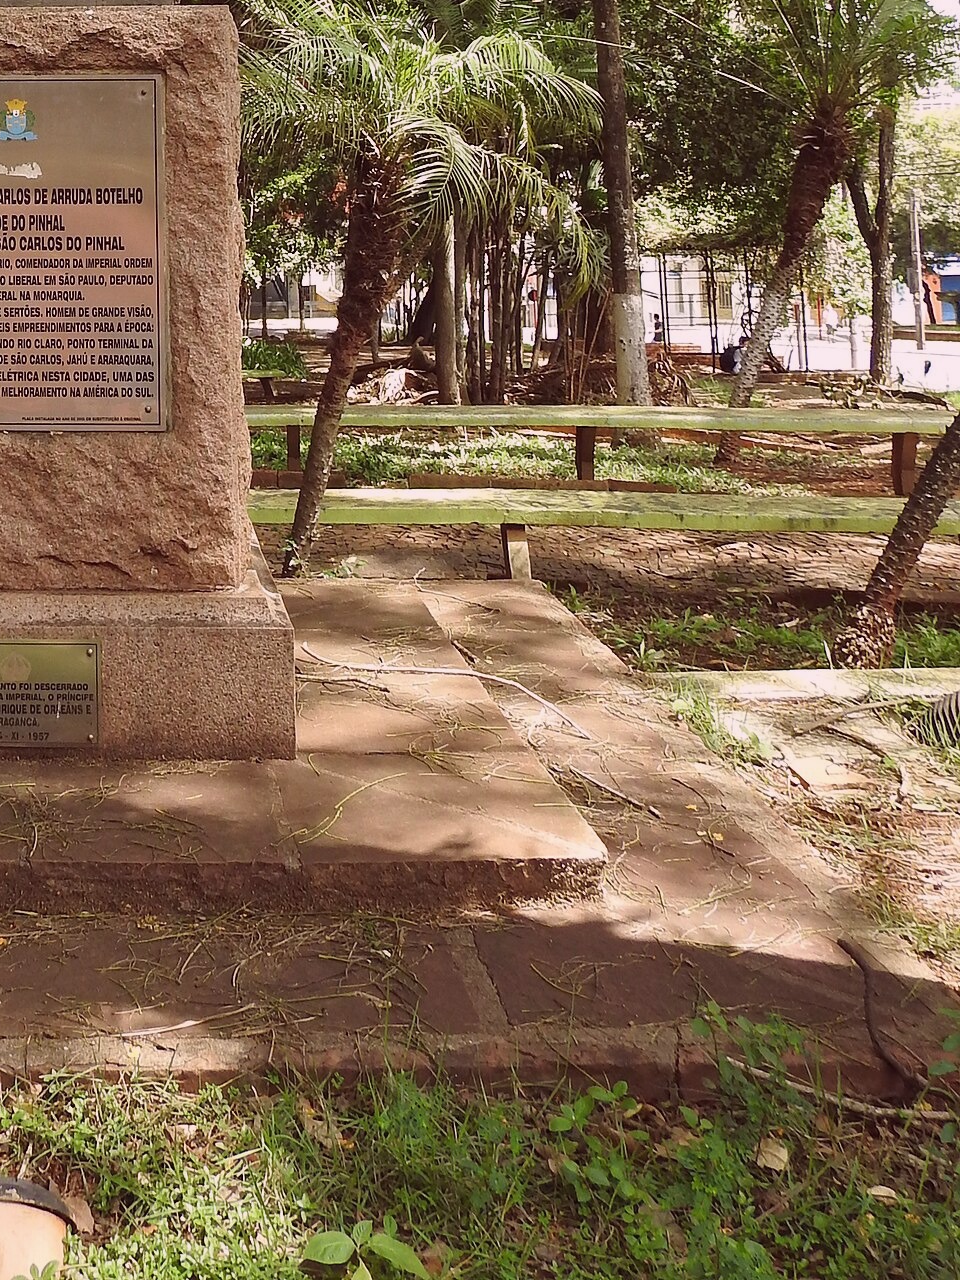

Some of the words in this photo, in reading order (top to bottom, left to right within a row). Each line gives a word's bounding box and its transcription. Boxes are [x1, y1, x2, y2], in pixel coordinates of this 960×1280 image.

[34, 188, 47, 204] DE
[51, 188, 92, 204] ARRUDA
[96, 188, 143, 204] BOTELHO
[12, 215, 25, 231] DO
[29, 215, 65, 231] PINHAL
[20, 236, 62, 251] CARLOS
[66, 236, 82, 251] DO
[86, 236, 124, 251] PINHAL
[16, 258, 70, 268] COMENDADOR
[72, 258, 83, 268] DA
[86, 258, 121, 268] IMPERIAL
[124, 258, 152, 268] ORDEM
[9, 275, 41, 285] LIBERAL
[44, 275, 56, 285] EM
[59, 273, 75, 285] SÃO
[78, 275, 107, 287] PAULO,
[110, 275, 153, 285] DEPUTADO
[20, 291, 30, 301] NA
[34, 291, 85, 302] MONARQUIA.
[46, 307, 76, 317] HOMEM
[79, 307, 89, 317] DE
[92, 307, 125, 317] GRANDE
[128, 304, 154, 318] VISÃO,
[13, 322, 91, 332] EMPREENDIMENTOS
[94, 322, 114, 332] PARA
[117, 322, 122, 332] A
[125, 320, 154, 332] ÉPOCA:
[18, 339, 32, 348] RIO
[34, 339, 64, 350] CLARO,
[68, 339, 95, 348] PONTO
[98, 339, 139, 348] TERMINAL
[142, 339, 153, 348] DA
[11, 352, 27, 364] SÃO
[30, 354, 64, 366] CARLOS,
[67, 352, 88, 364] JAHÚ
[90, 354, 95, 364] E
[98, 354, 154, 366] ARARAQUARA,
[42, 371, 70, 381] NESTA
[74, 372, 109, 383] CIDADE,
[112, 371, 132, 381] UMA
[136, 371, 154, 381] DAS
[2, 387, 67, 397] MELHORAMENTO
[70, 387, 80, 397] NA
[83, 385, 118, 397] AMÉRICA
[121, 387, 132, 397] DO
[135, 387, 154, 397] SUL.
[57, 692, 93, 701] PRÍNCIPE
[30, 704, 41, 714] DE
[86, 704, 91, 714] E
[11, 732, 18, 740] XI
[28, 732, 49, 741] 1957
